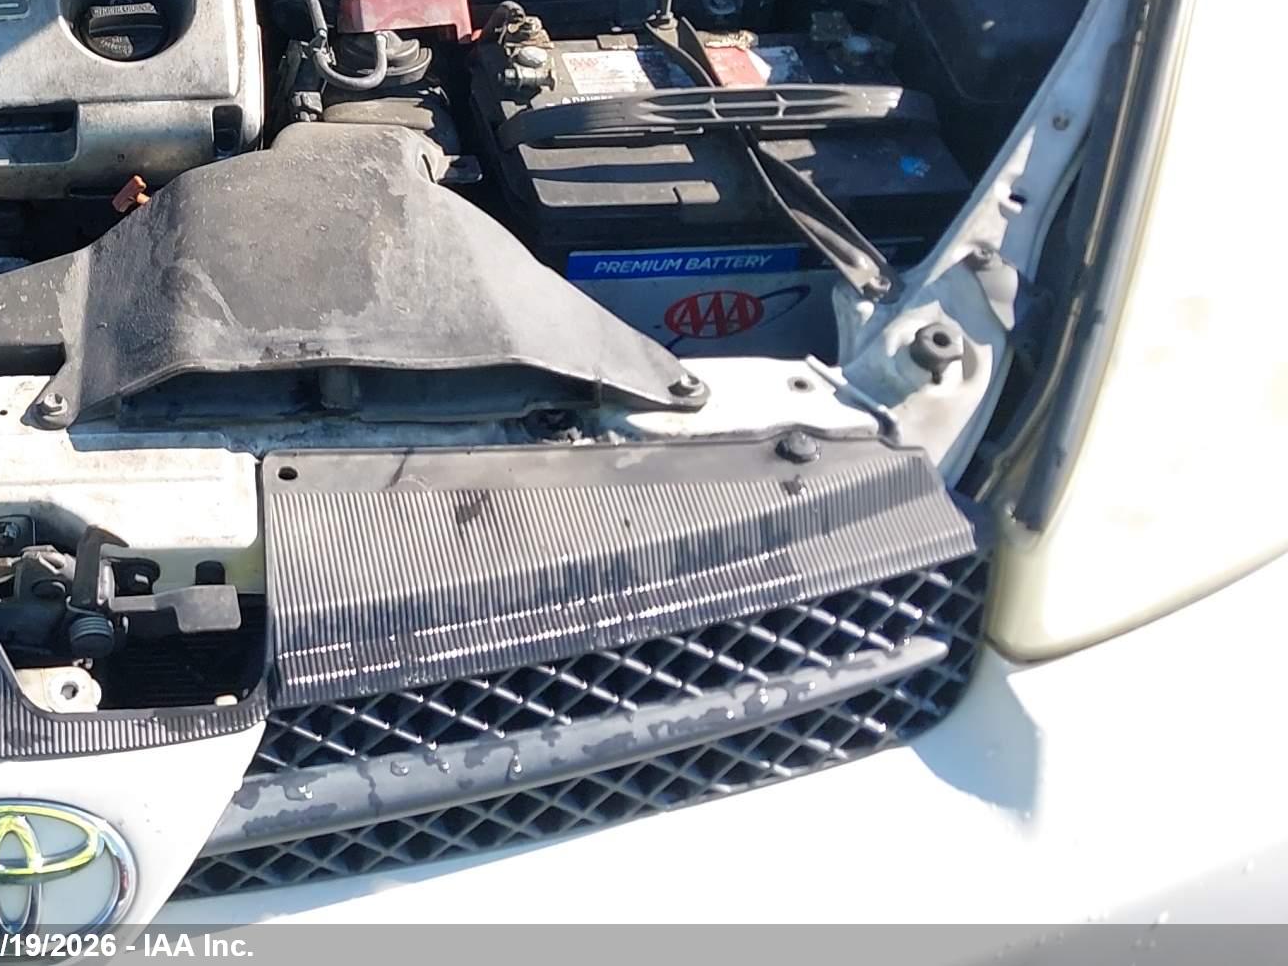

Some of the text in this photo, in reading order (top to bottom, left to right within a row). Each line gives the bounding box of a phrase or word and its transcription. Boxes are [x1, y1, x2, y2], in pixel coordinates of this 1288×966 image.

[594, 253, 773, 274] PREMIUM BATTERY
[672, 291, 758, 338] AAA
